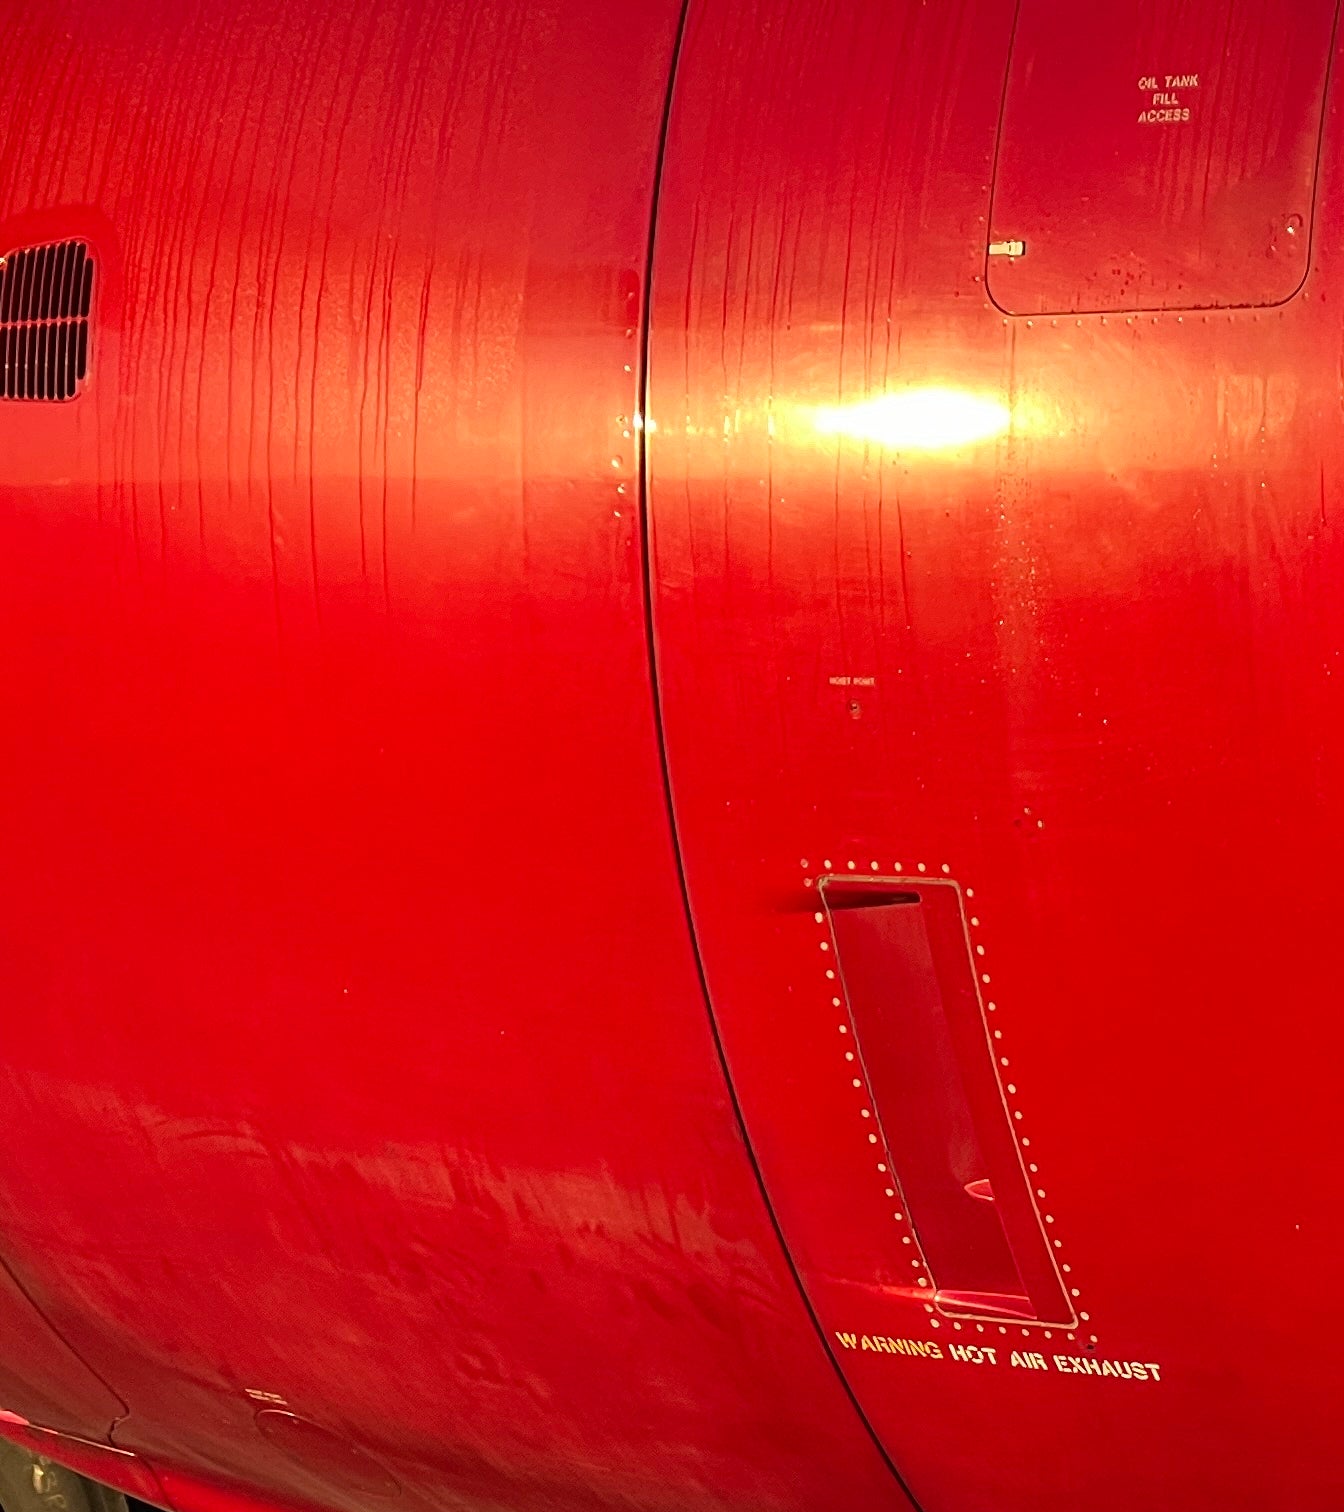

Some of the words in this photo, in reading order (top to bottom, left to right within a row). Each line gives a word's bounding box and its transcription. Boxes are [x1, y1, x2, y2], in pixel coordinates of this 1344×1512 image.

[1138, 77, 1158, 90] OIL
[1165, 74, 1198, 87] TANK
[1153, 93, 1178, 105] FILL
[1138, 108, 1189, 122] ACCESS
[836, 1332, 943, 1358] WARNING
[950, 1344, 996, 1364] HOT
[1011, 1351, 1048, 1370] AIR
[1055, 1355, 1160, 1381] EXHAUST
